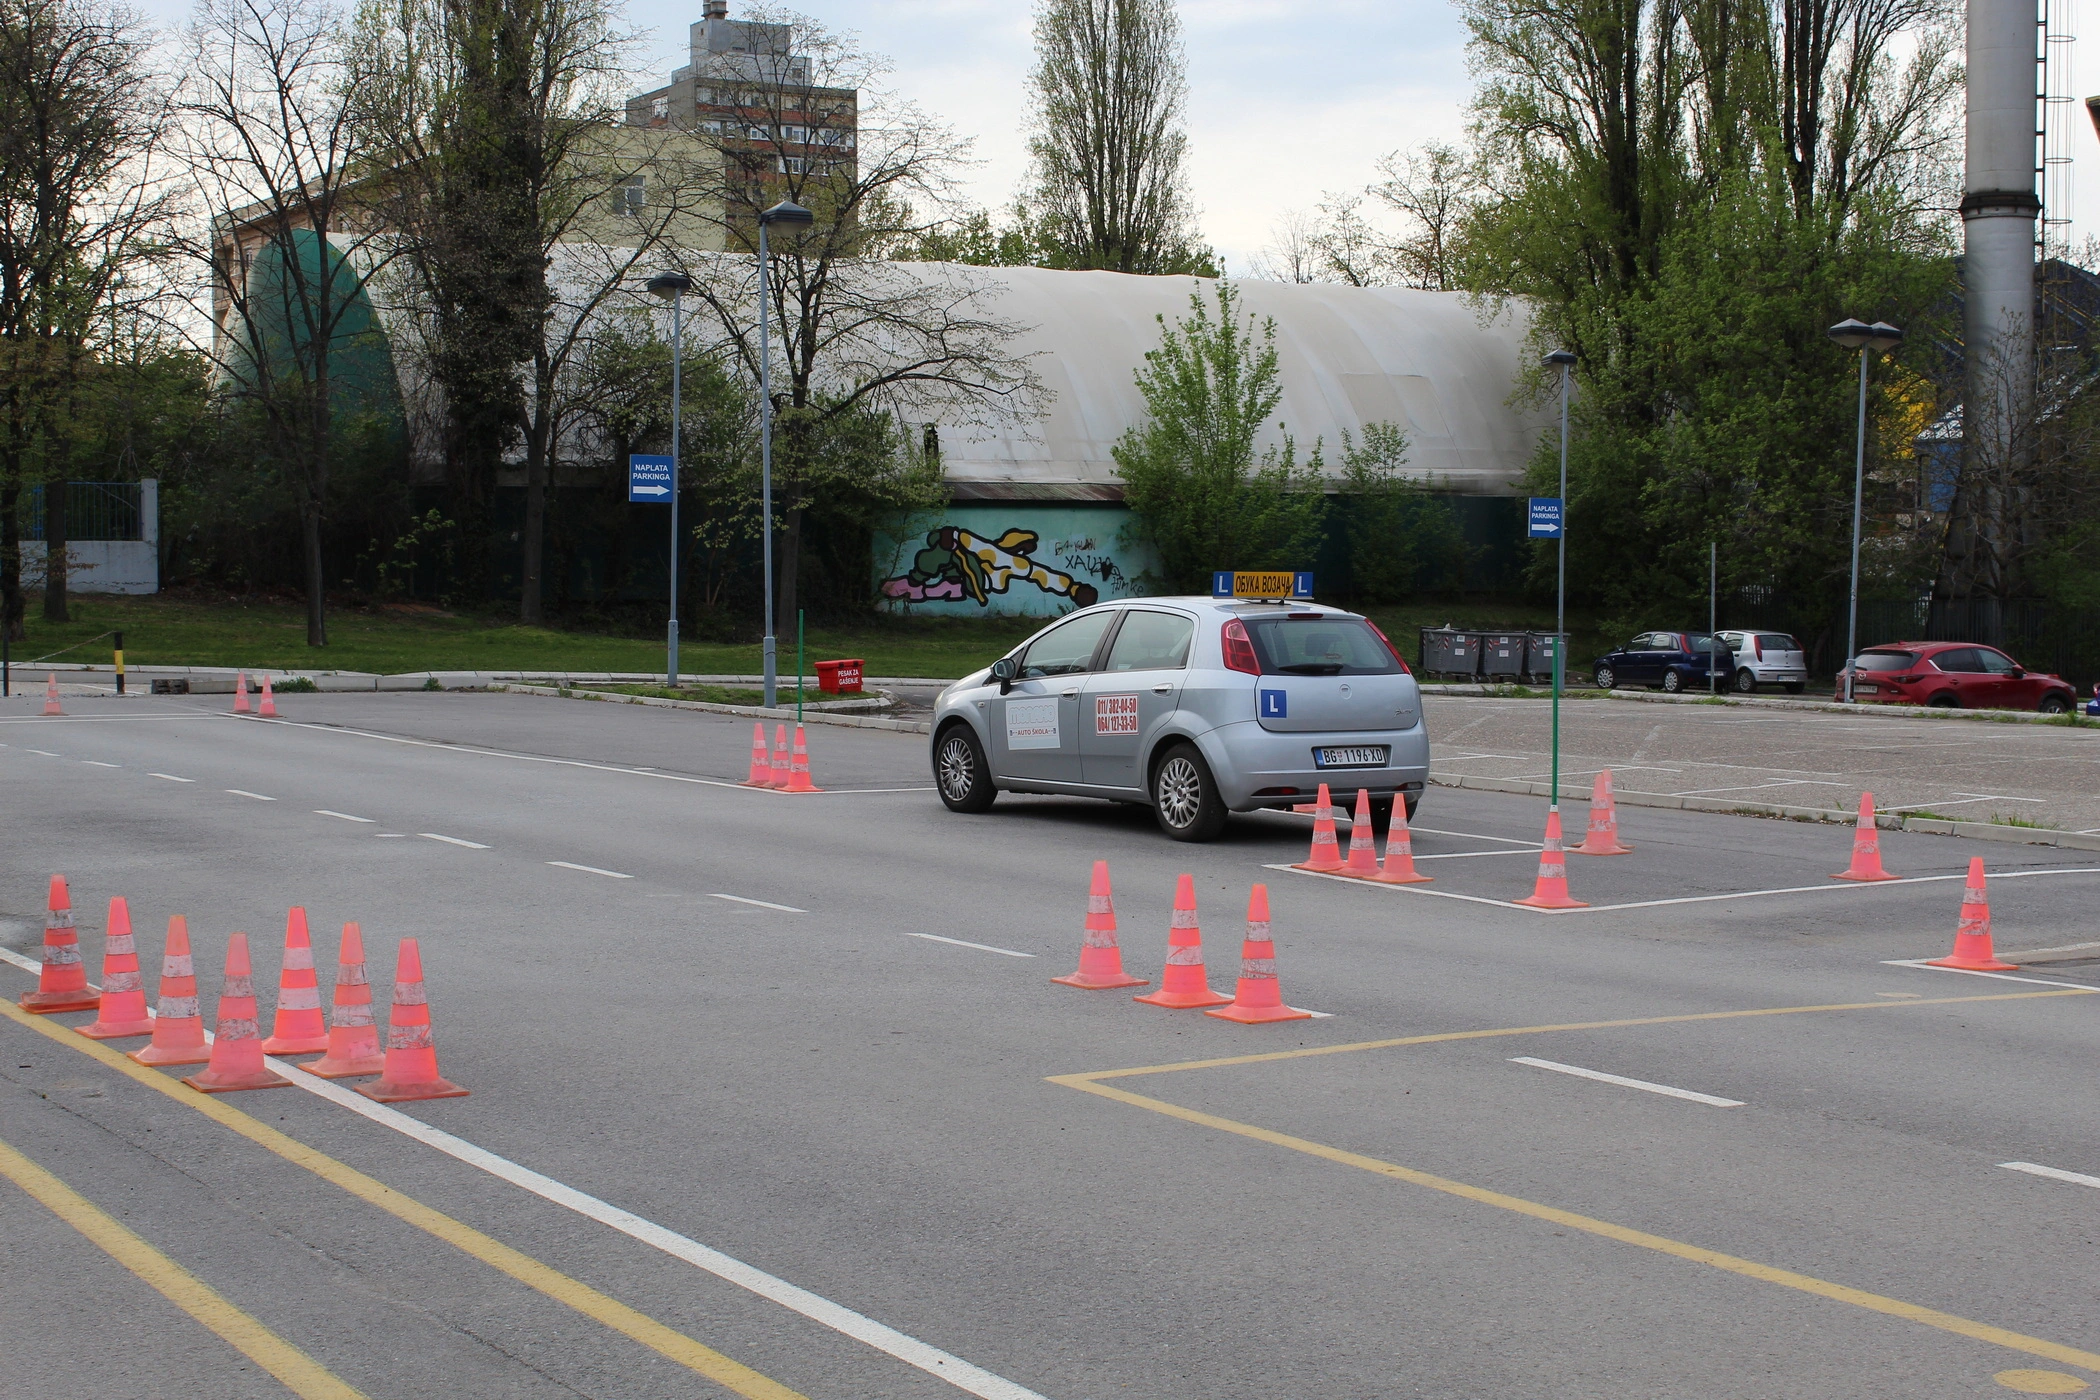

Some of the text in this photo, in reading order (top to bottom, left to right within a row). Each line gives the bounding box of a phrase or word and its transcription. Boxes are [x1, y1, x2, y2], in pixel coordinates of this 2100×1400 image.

[1218, 575, 1228, 593] L
[1235, 575, 1290, 593] ОБУКА ВОЗАЧА
[1298, 575, 1307, 593] L
[838, 669, 852, 677] PESAK
[1269, 695, 1278, 712] L
[1323, 750, 1337, 763] BG
